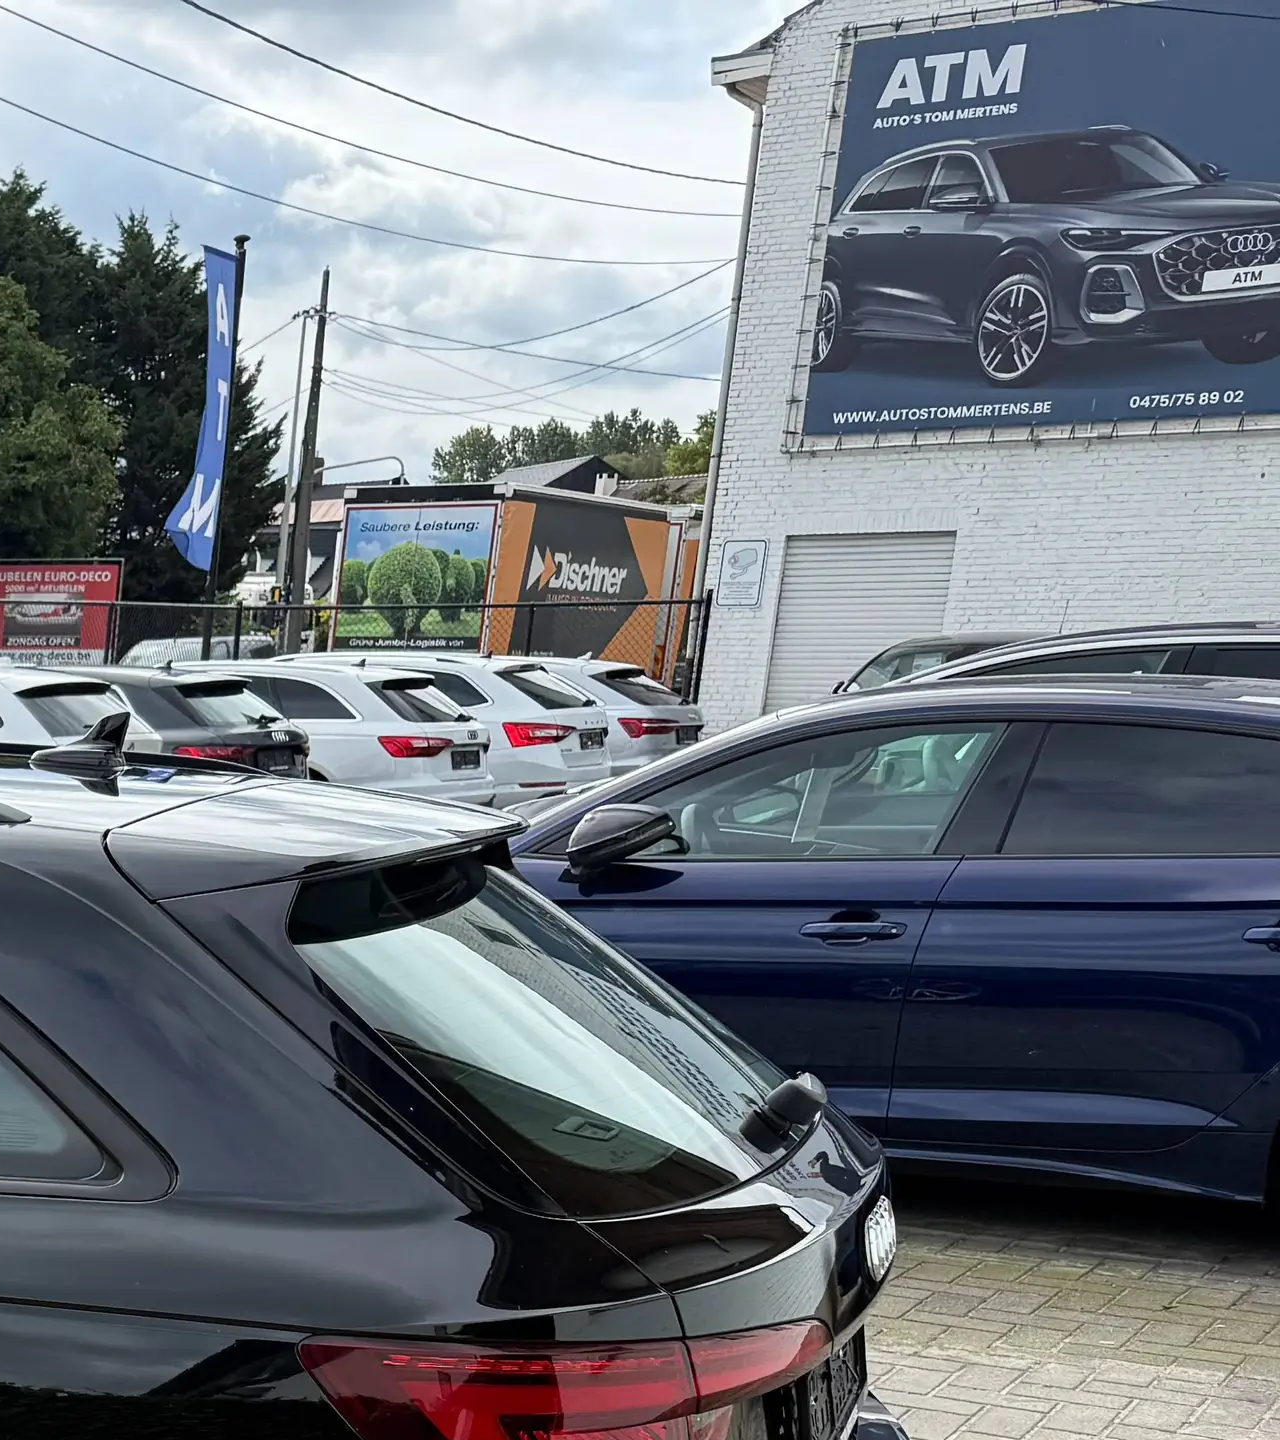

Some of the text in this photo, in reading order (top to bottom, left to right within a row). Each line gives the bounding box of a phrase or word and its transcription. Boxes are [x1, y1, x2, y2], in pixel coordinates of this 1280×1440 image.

[875, 43, 1028, 109] ATM
[872, 102, 1018, 130] AUTO'S TOM MERTENS
[1231, 270, 1263, 285] ATM
[1129, 390, 1244, 409] 0475/75 89 02
[832, 400, 1052, 424] WWW.AUTOSTOMMERTENS.BE
[360, 520, 480, 533] Saubere Leistung:
[44, 570, 112, 582] EURO-DECO
[548, 551, 628, 595] Dischner
[39, 584, 86, 593] MEUBELEN
[6, 635, 76, 647] ZONDAG OPEN
[375, 638, 447, 649] Jumbo-Logistik
